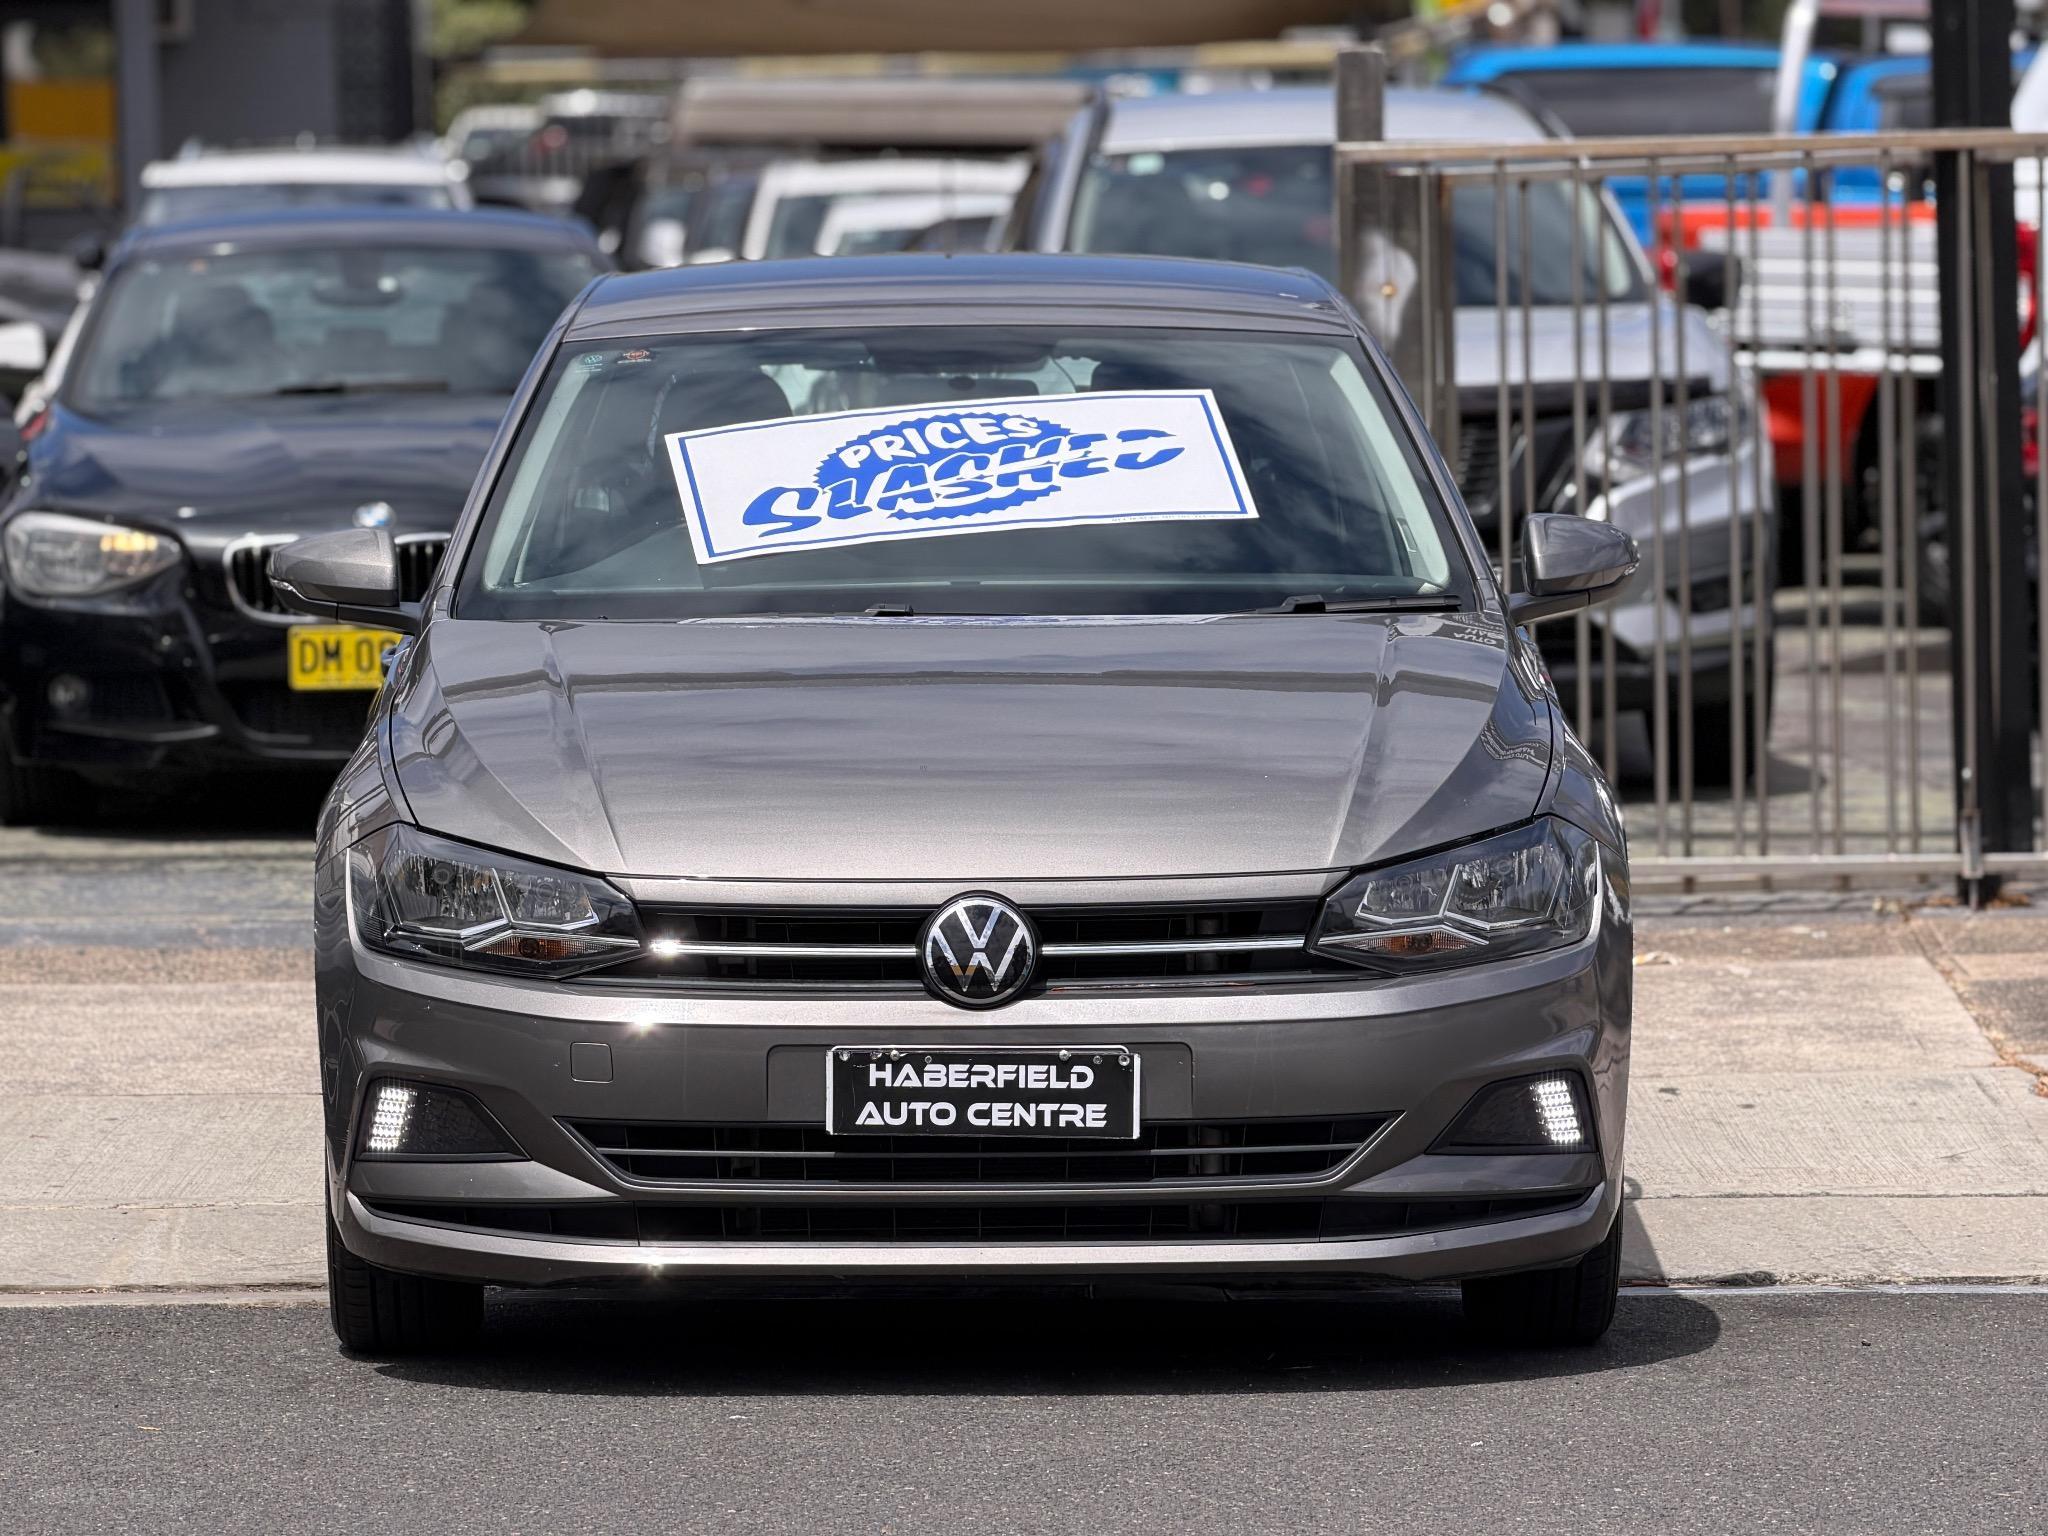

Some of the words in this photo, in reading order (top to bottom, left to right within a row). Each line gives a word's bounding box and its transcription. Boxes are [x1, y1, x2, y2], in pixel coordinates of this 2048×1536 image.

[838, 417, 1042, 469] PRICES
[742, 429, 1186, 538] SLASHED
[300, 638, 342, 673] DM
[868, 1063, 1094, 1089] HABERFIELD
[855, 1101, 957, 1126] AUTO
[967, 1103, 1107, 1128] CENTRE
